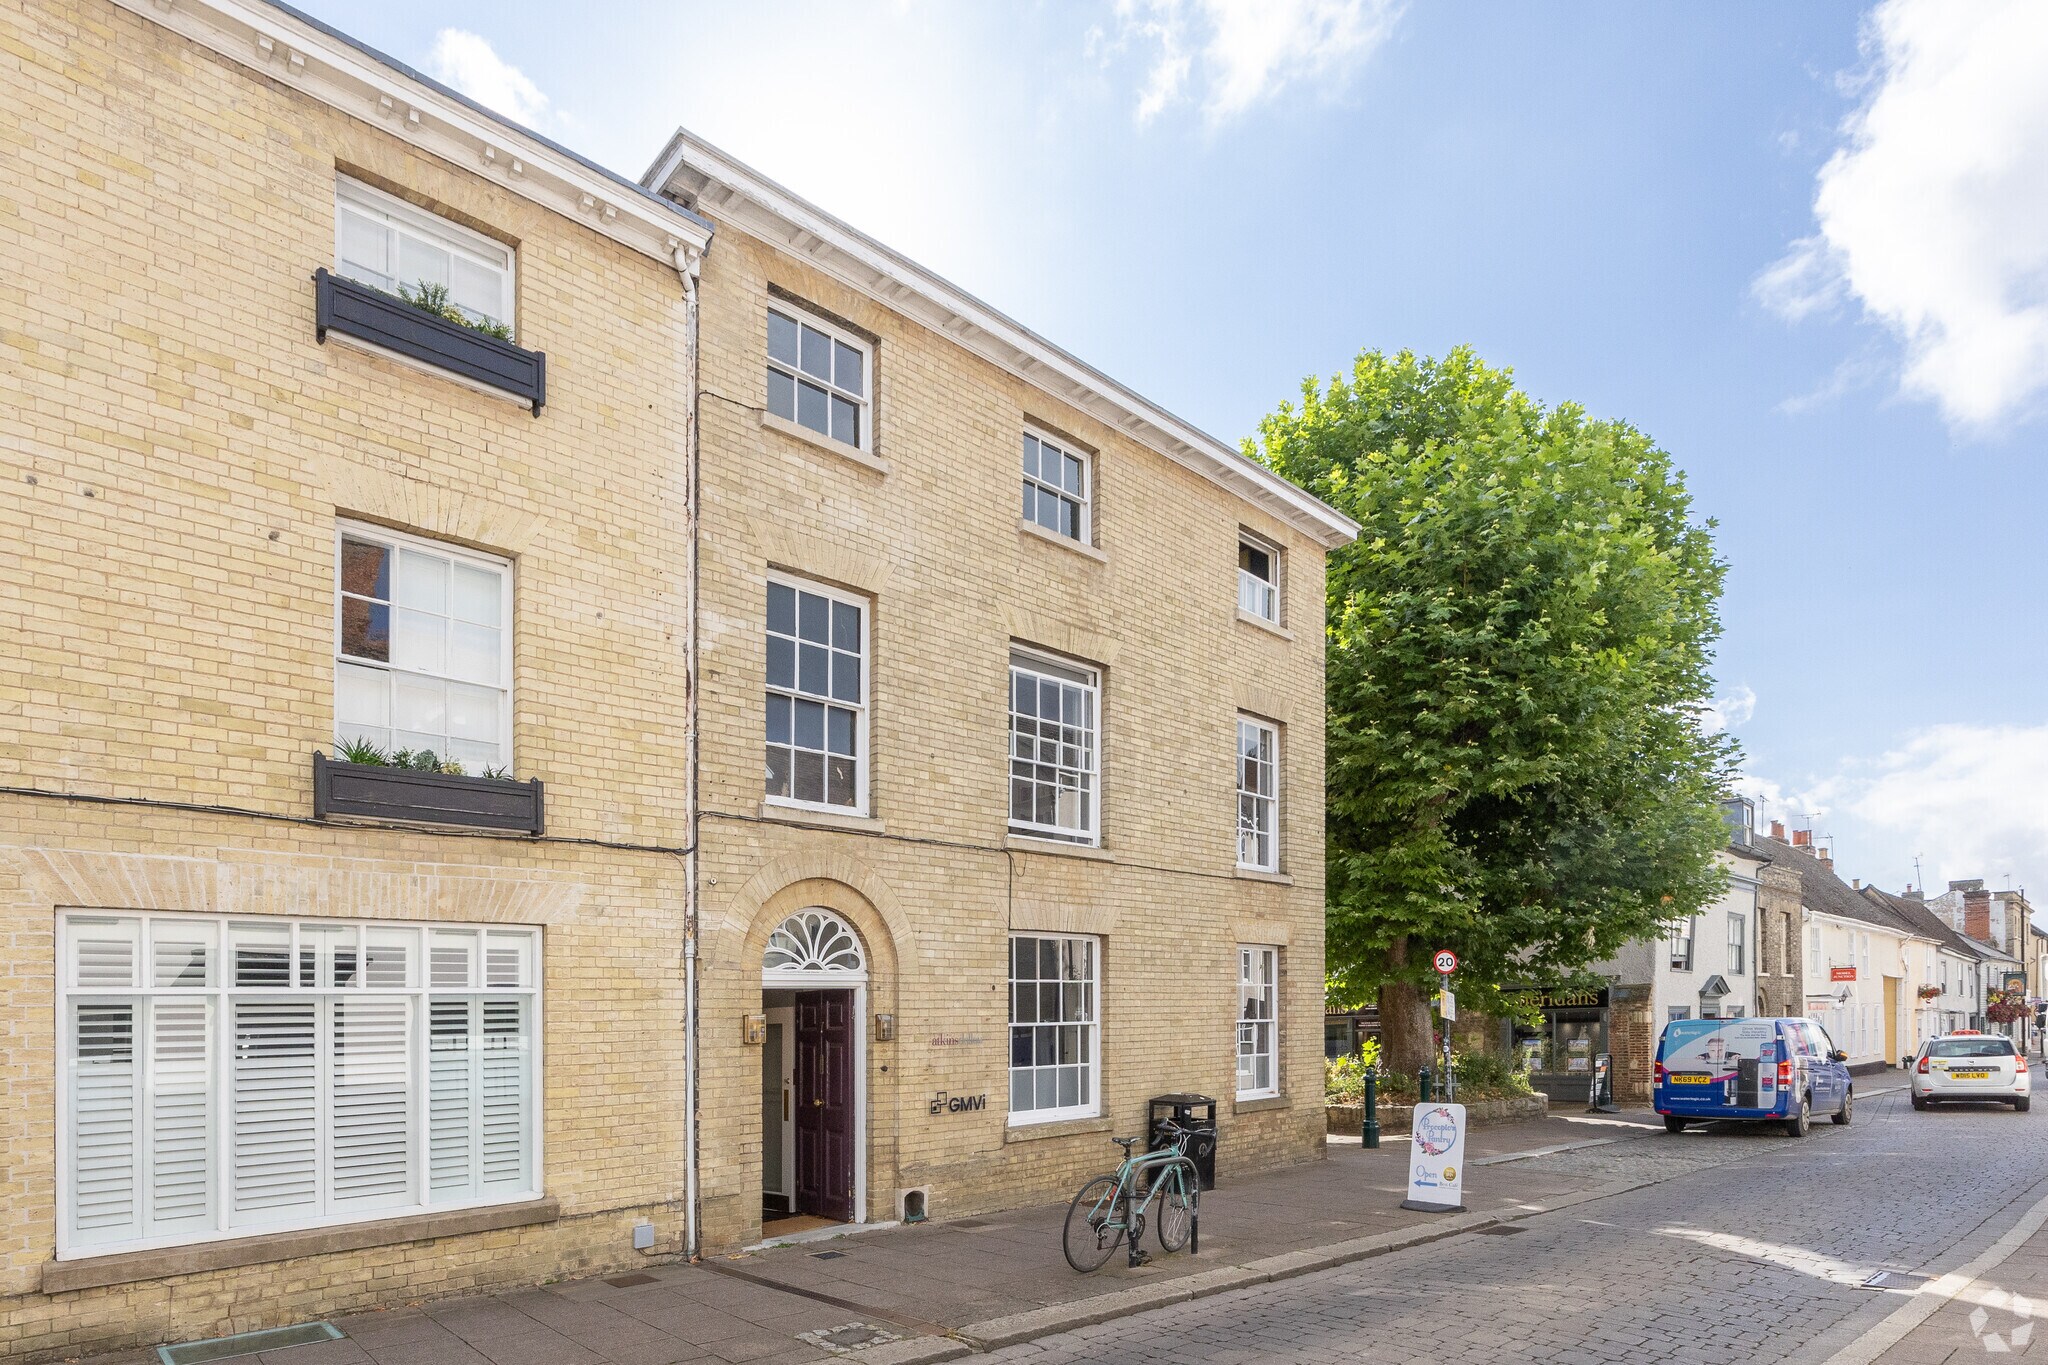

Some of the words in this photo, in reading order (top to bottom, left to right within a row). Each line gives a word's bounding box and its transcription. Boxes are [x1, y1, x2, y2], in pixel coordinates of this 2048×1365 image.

[1437, 957, 1454, 967] 20
[949, 1094, 986, 1112] GMVi
[1416, 1165, 1437, 1181] Open
